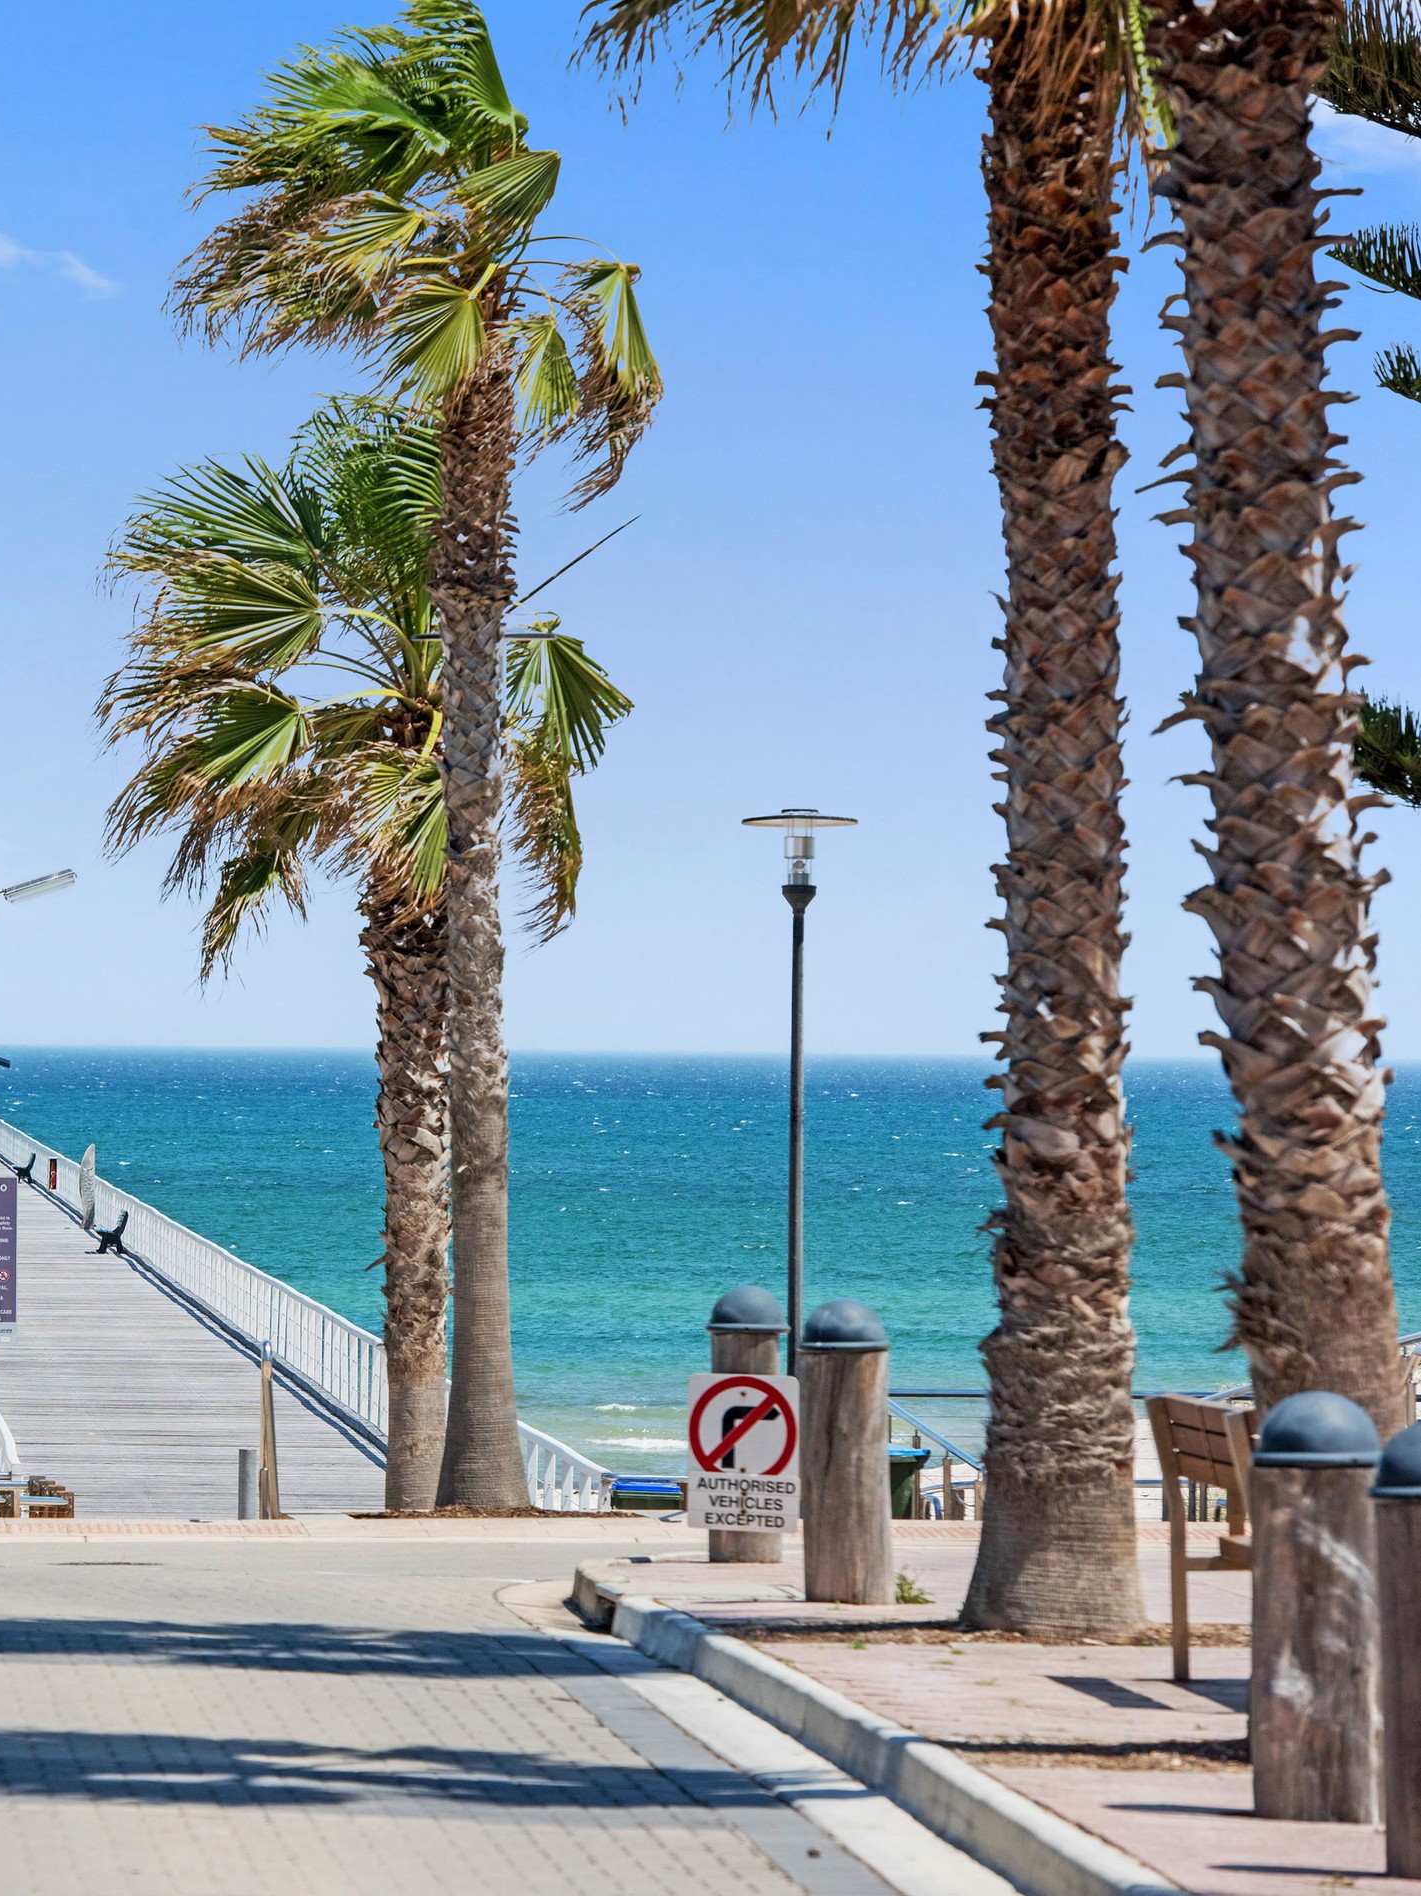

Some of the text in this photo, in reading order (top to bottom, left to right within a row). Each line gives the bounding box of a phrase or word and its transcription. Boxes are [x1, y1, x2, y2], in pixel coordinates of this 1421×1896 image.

[697, 1478, 796, 1494] AUTHORISED
[709, 1495, 784, 1511] VEHICLES
[705, 1512, 785, 1528] EXCEPTED
